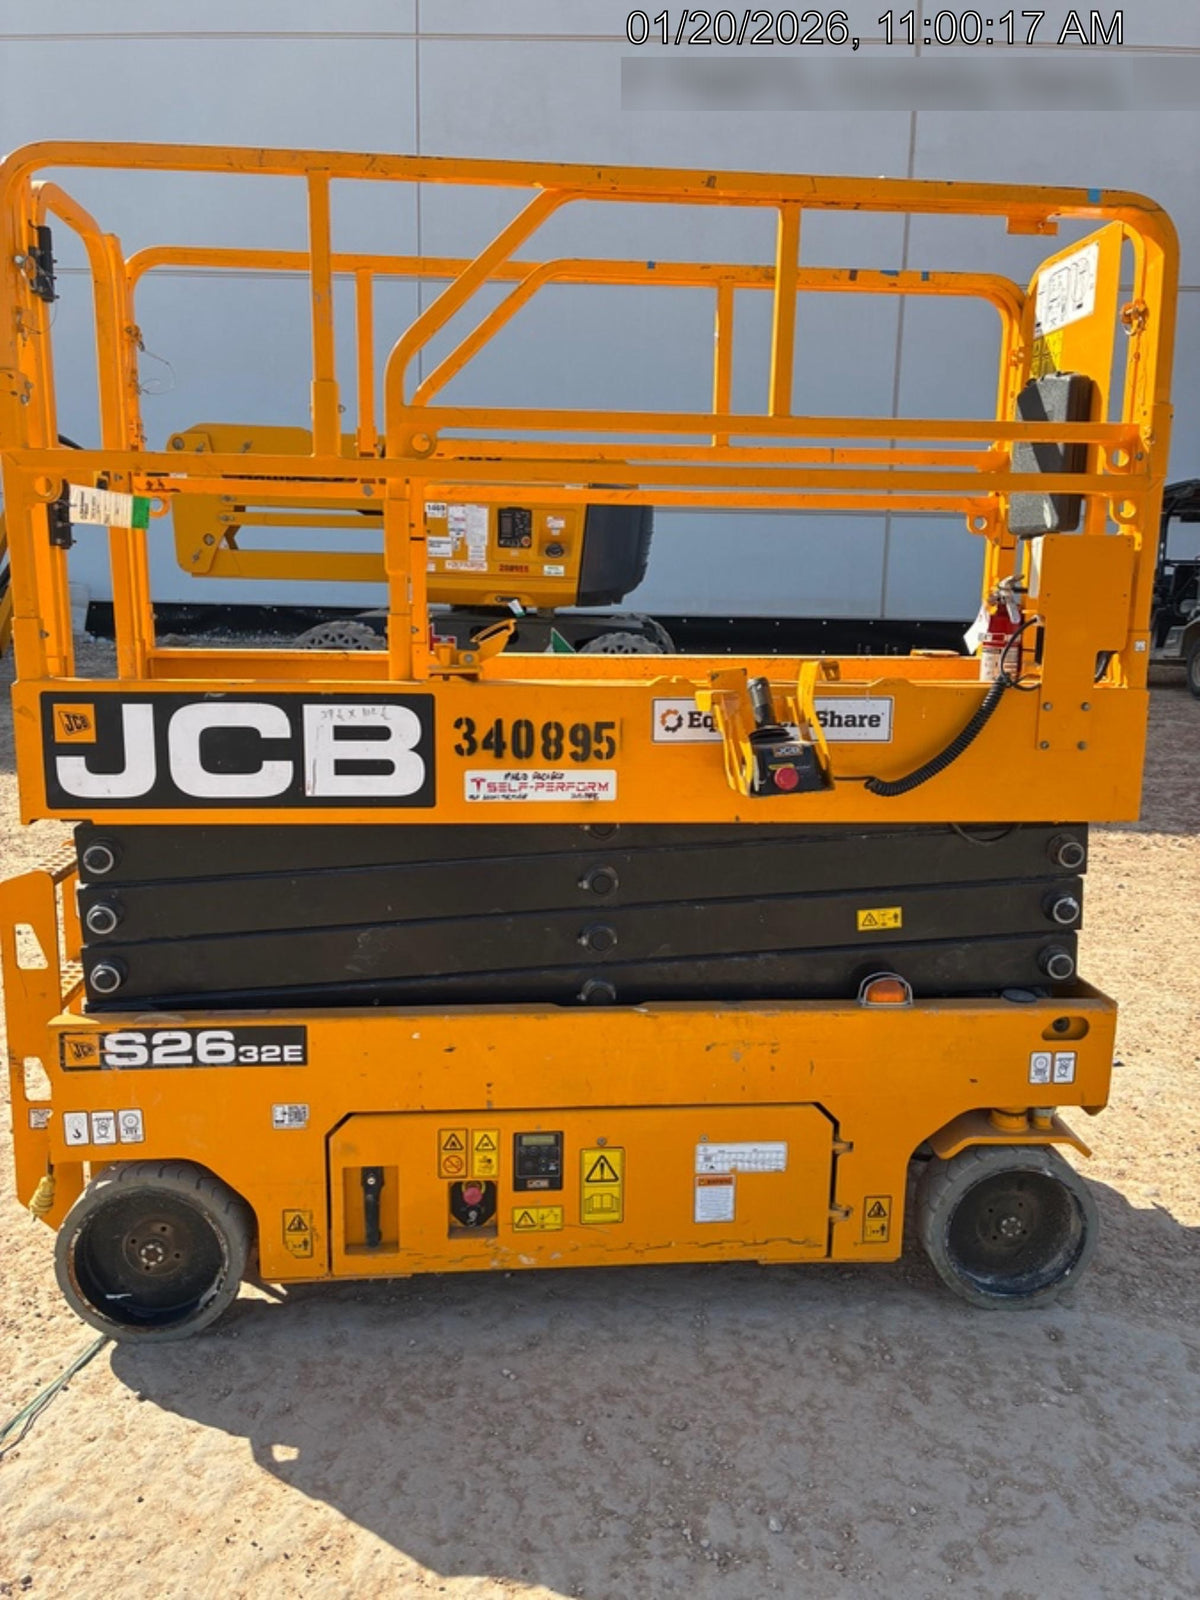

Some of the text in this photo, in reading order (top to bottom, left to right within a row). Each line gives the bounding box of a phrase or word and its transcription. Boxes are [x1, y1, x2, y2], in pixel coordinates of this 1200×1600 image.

[64, 712, 90, 733] JCB
[453, 717, 616, 762] 340895
[56, 702, 425, 798] JCB
